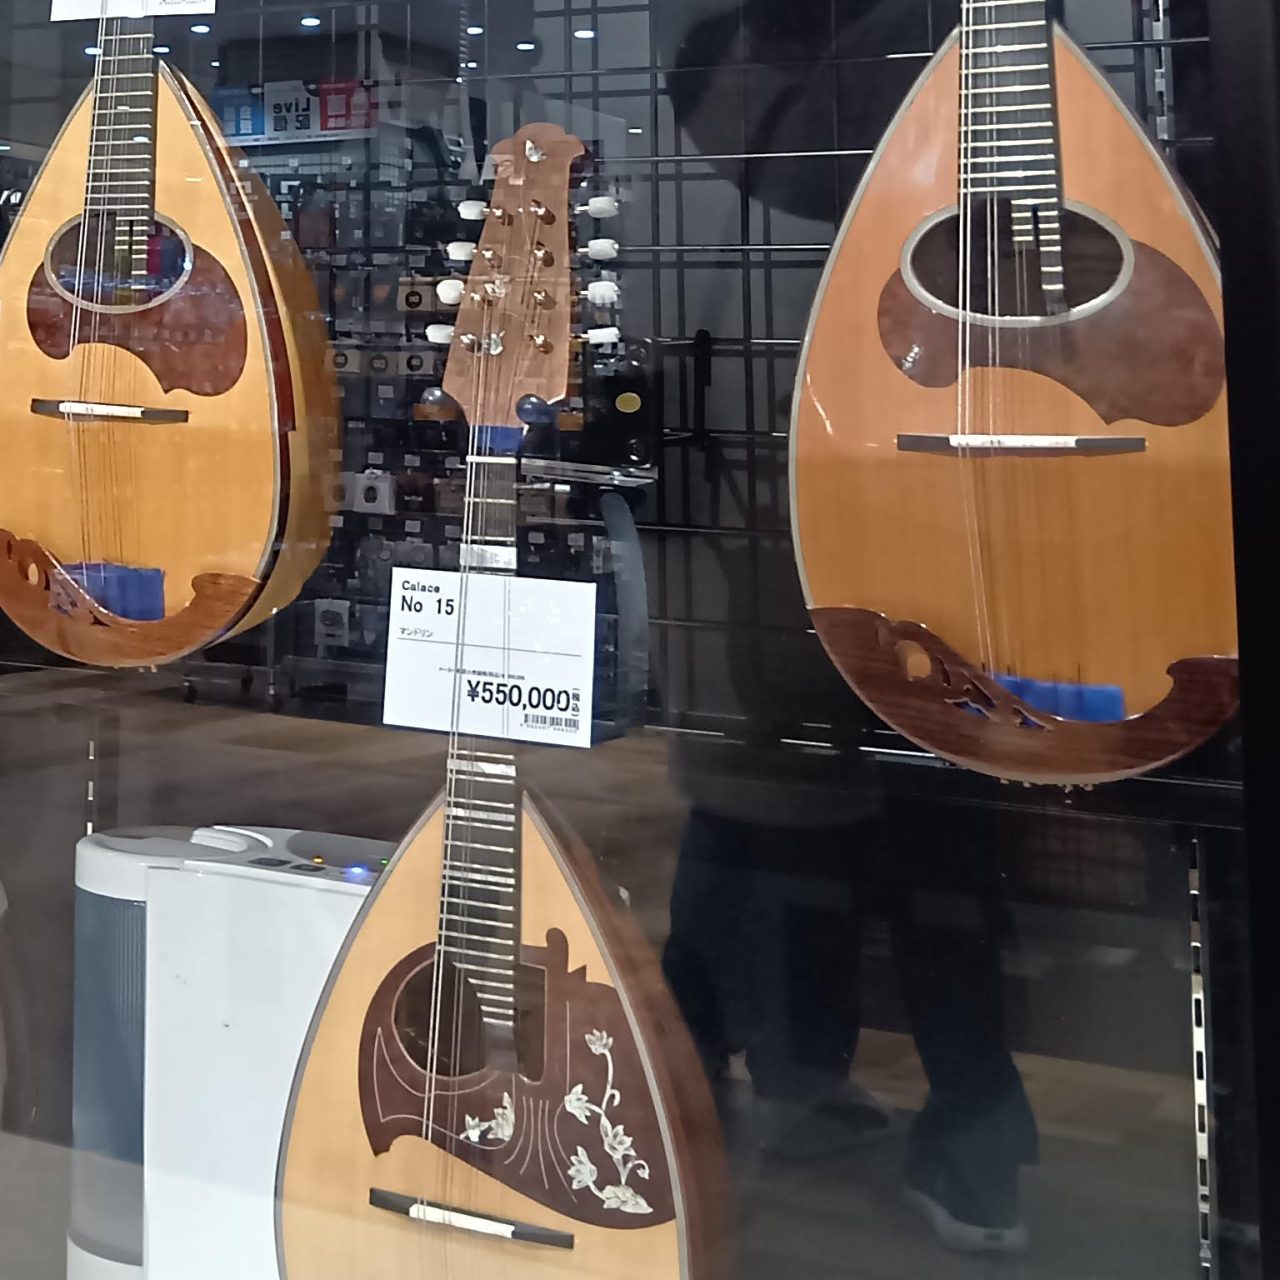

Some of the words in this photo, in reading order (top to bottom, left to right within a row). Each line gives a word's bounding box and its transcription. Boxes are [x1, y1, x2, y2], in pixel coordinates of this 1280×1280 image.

[402, 580, 440, 593] Calace
[400, 595, 423, 613] No
[436, 598, 455, 615] 15
[467, 679, 571, 712] ¥550,000
